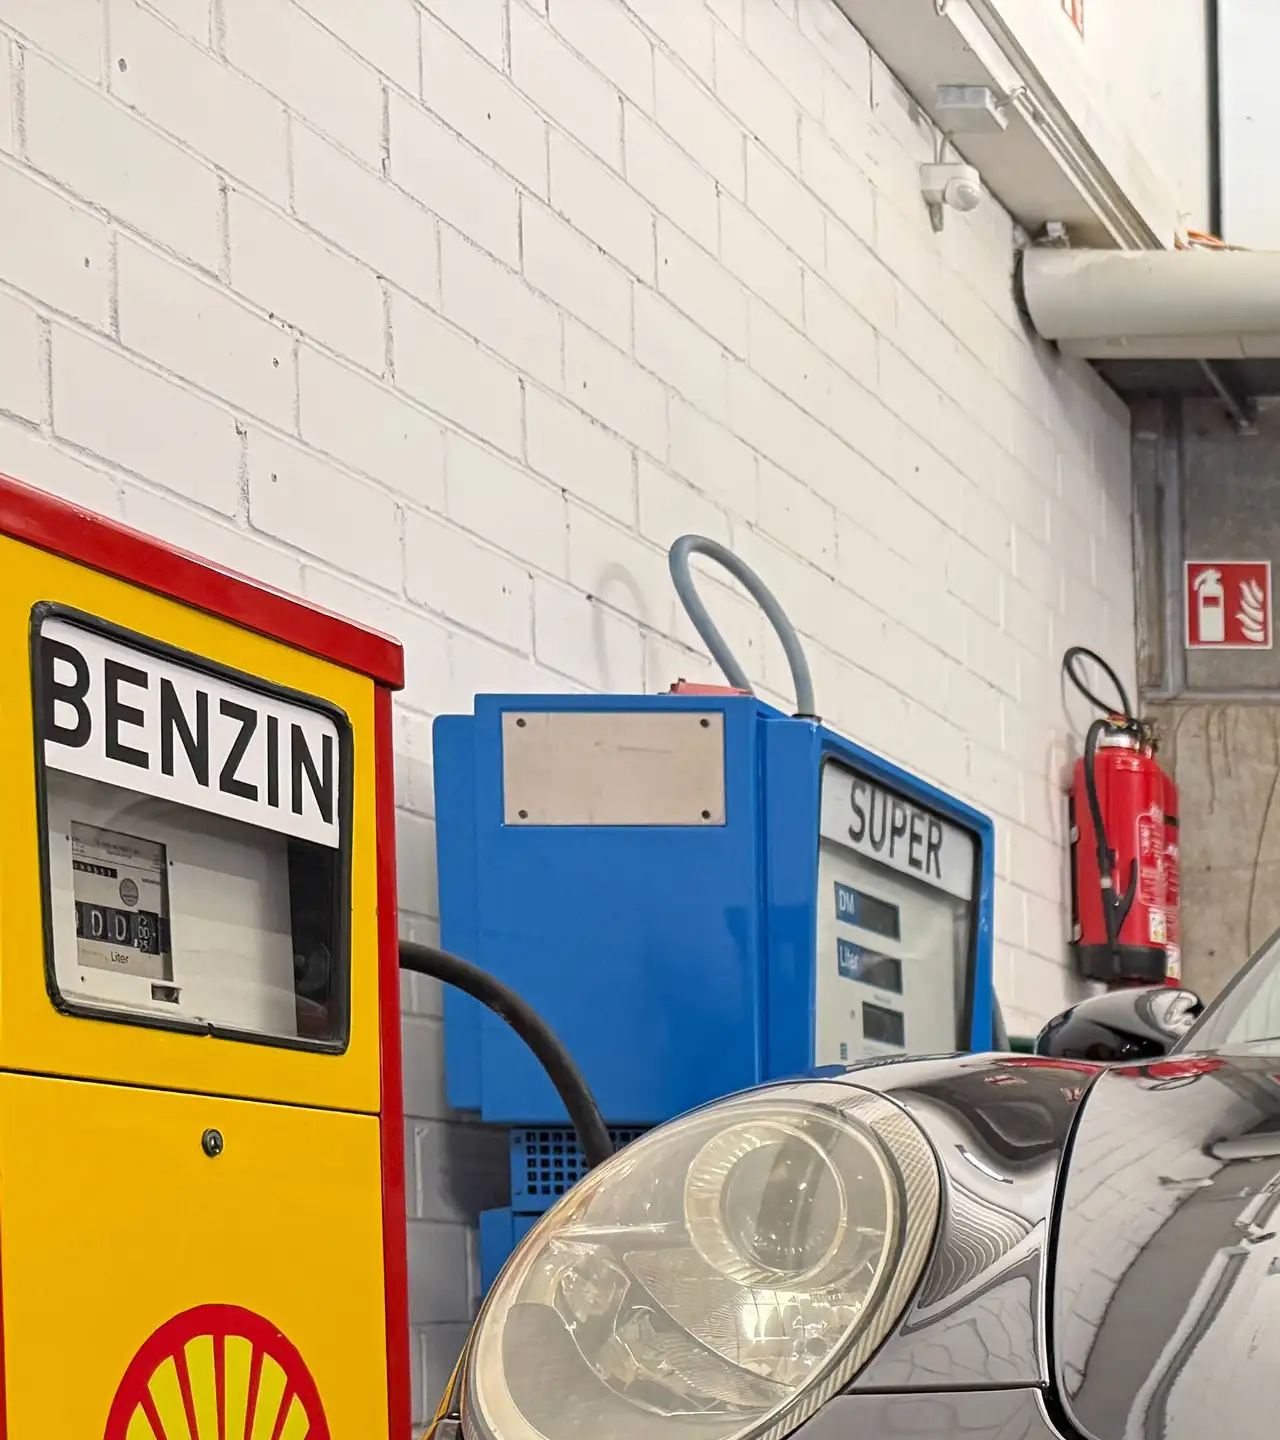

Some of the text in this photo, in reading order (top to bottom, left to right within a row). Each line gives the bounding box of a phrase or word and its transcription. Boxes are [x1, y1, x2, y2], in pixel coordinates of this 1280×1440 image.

[42, 636, 333, 825] BENZIN
[848, 779, 943, 880] SUPER
[839, 889, 855, 915] DM
[111, 950, 129, 964] Liter
[839, 944, 859, 970] Liter
